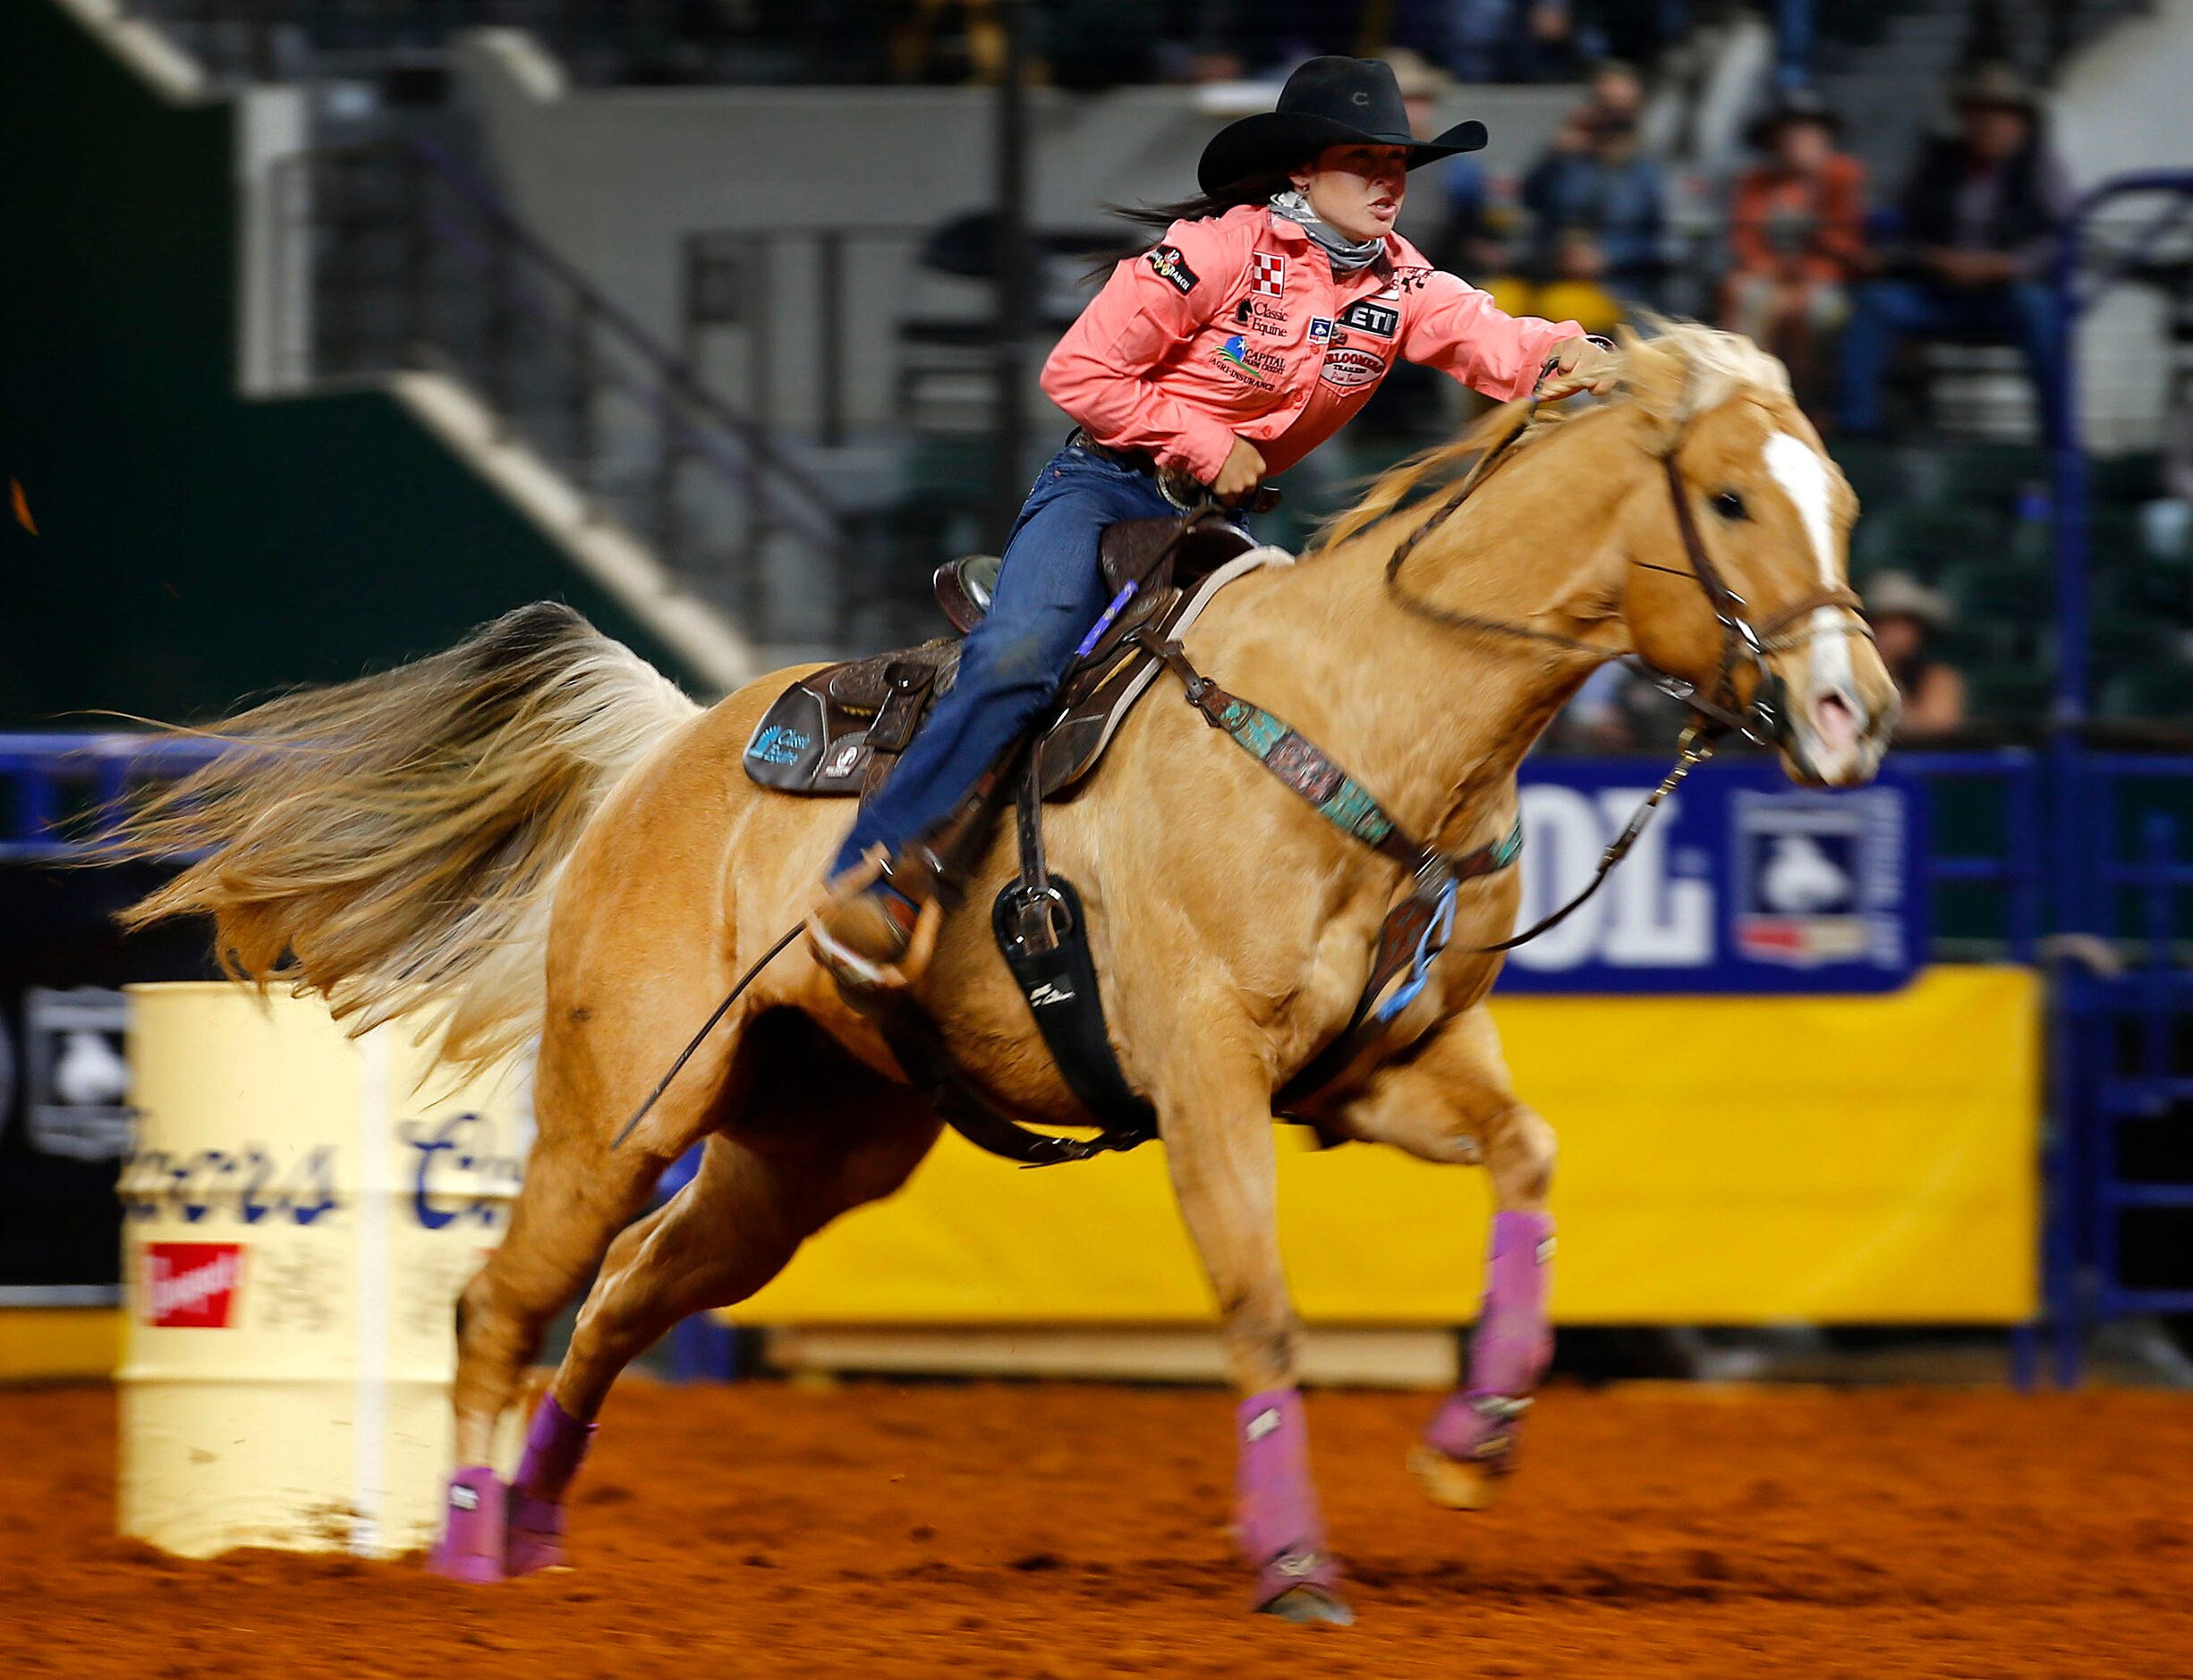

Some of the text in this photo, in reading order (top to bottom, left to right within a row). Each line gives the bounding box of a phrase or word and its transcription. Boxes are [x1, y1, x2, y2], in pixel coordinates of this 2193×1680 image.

[1254, 301, 1288, 322] Classic
[1252, 317, 1288, 337] Equine
[1245, 348, 1286, 368] CAPITAL
[1210, 357, 1276, 391] AGRI-INSURANCE
